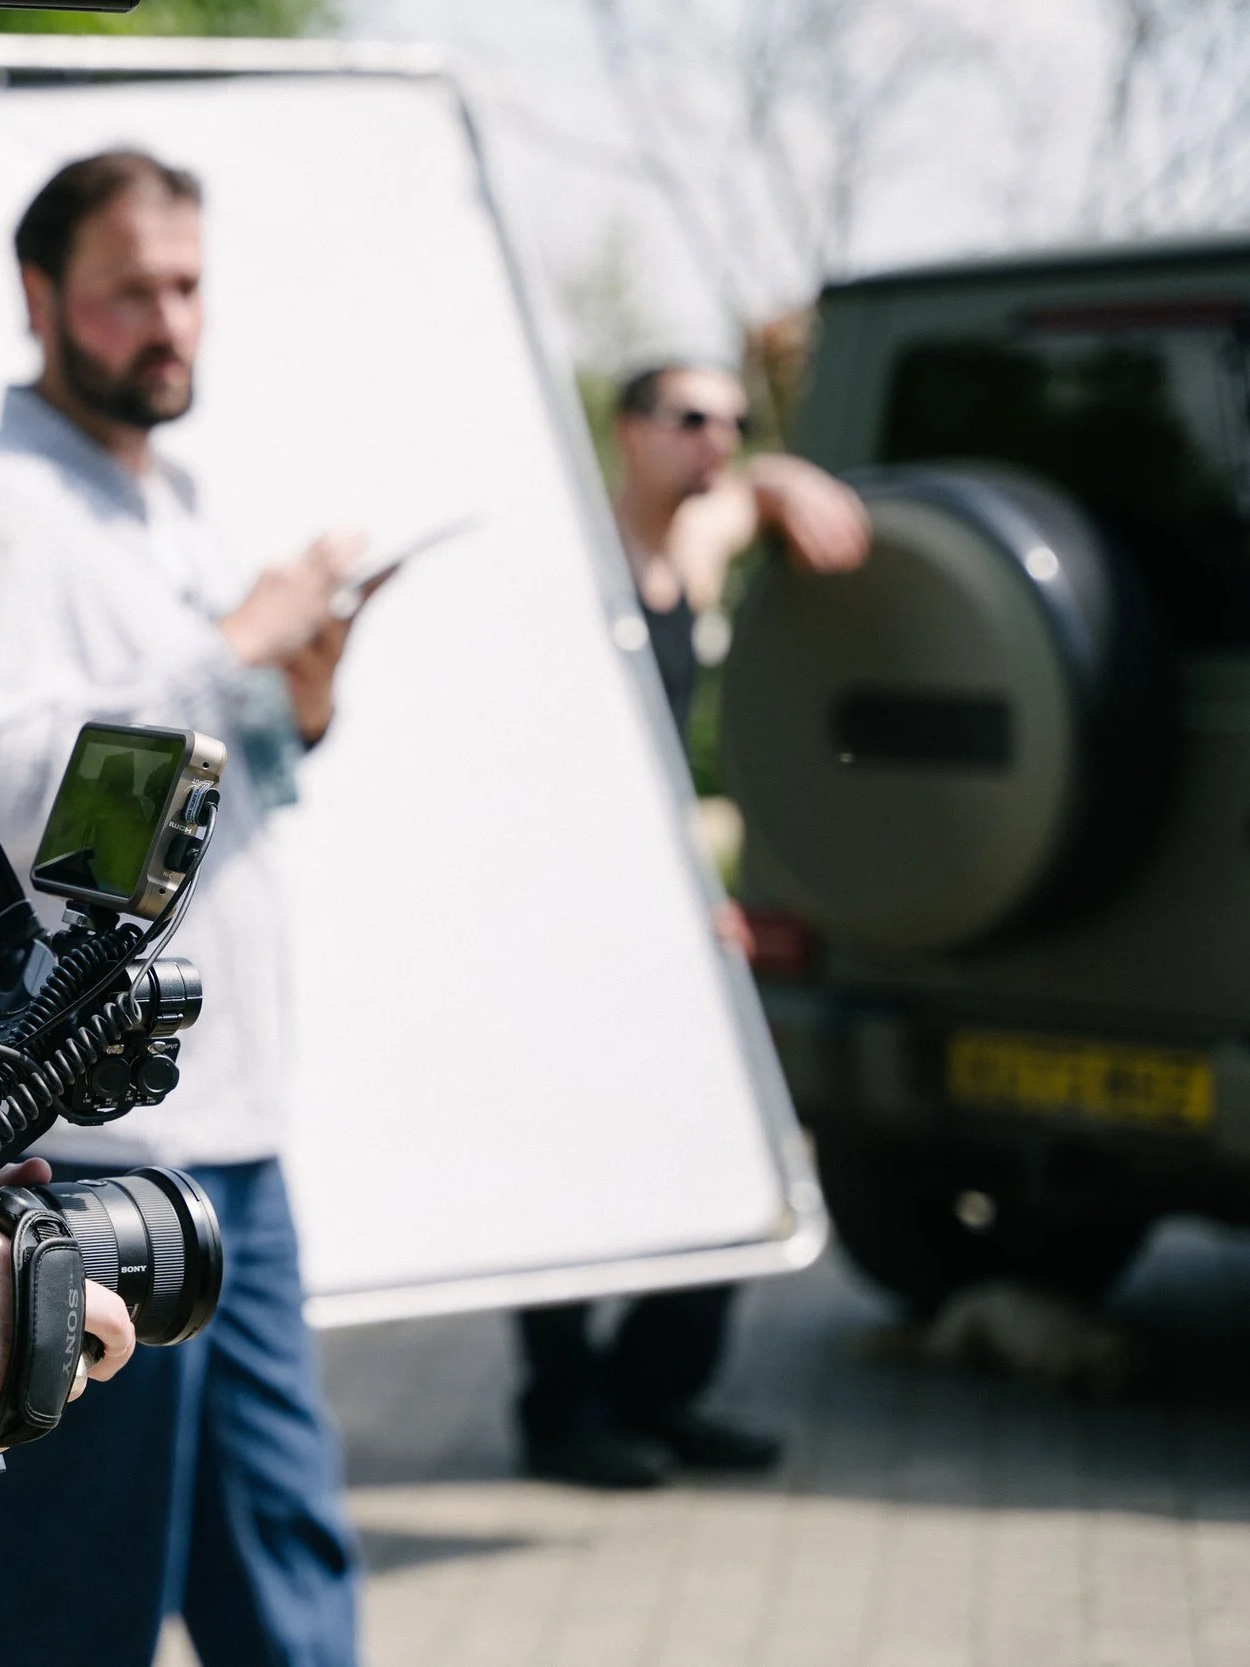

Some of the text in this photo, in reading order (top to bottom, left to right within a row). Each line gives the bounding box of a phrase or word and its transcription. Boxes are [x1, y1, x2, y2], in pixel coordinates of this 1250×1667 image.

[168, 821, 192, 834] HDMI
[121, 1265, 147, 1273] SONY
[62, 1289, 79, 1376] SONY
